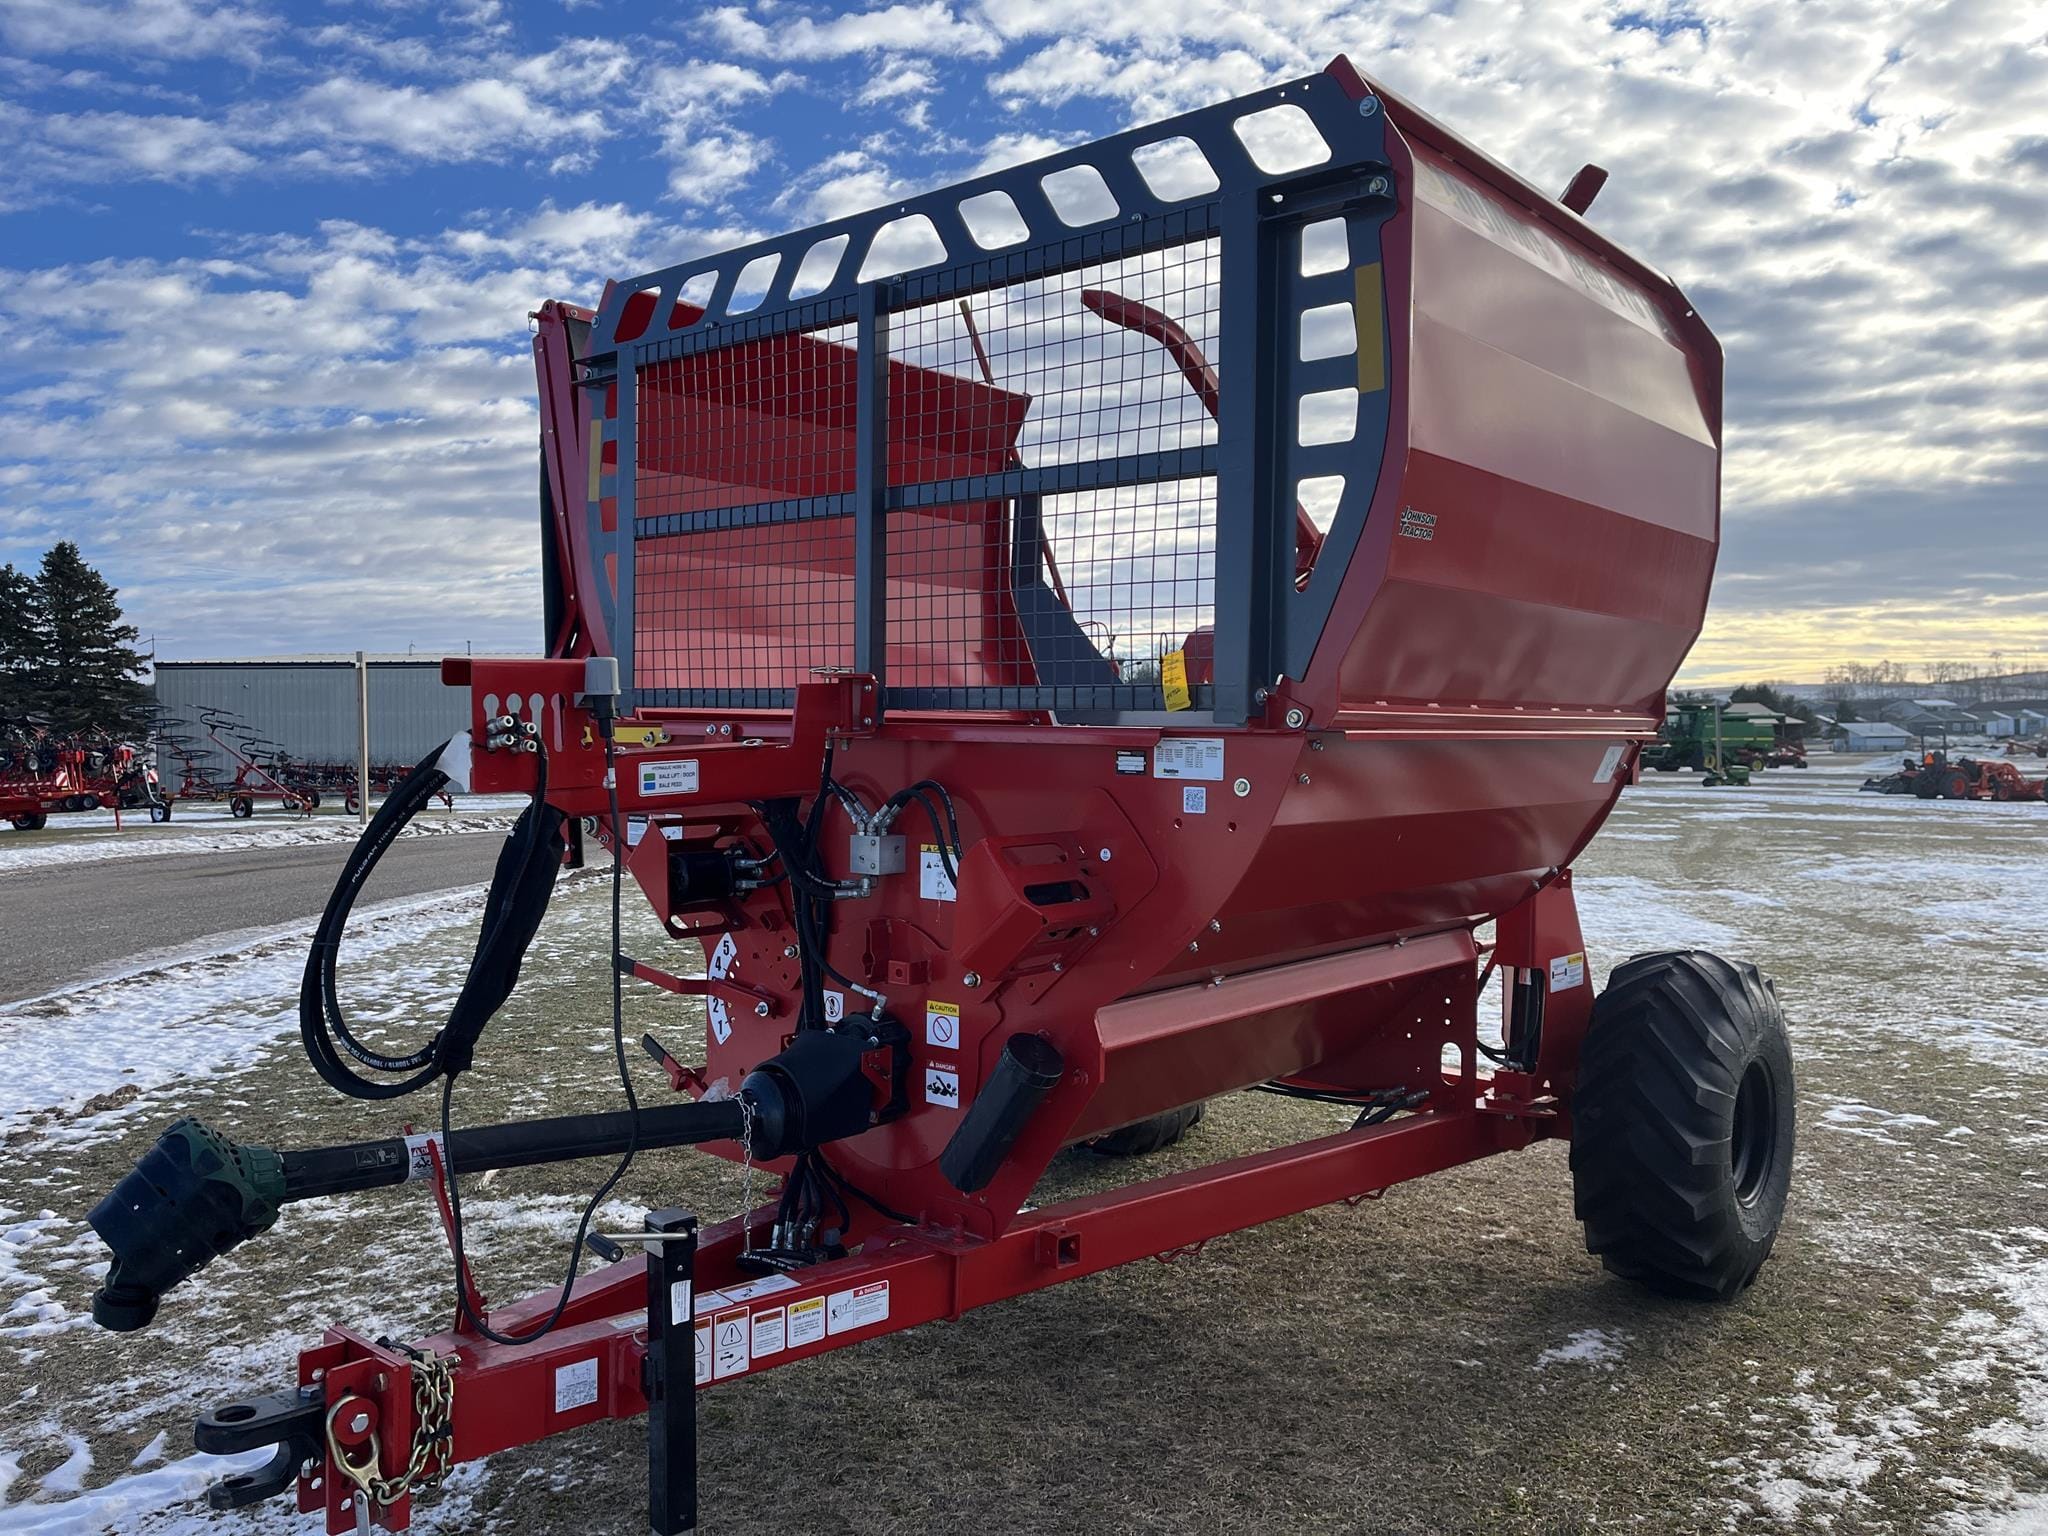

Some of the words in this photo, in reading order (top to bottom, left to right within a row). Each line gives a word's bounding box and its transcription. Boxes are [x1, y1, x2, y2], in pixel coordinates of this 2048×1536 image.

[1401, 506, 1436, 525] JOHNSON
[1400, 521, 1433, 539] TRACTOR
[723, 940, 730, 956] 5
[715, 956, 721, 971] 4
[713, 997, 719, 1013] 2
[935, 1005, 957, 1013] CAUTION
[718, 1020, 723, 1035] 1
[935, 1062, 956, 1071] DANGER
